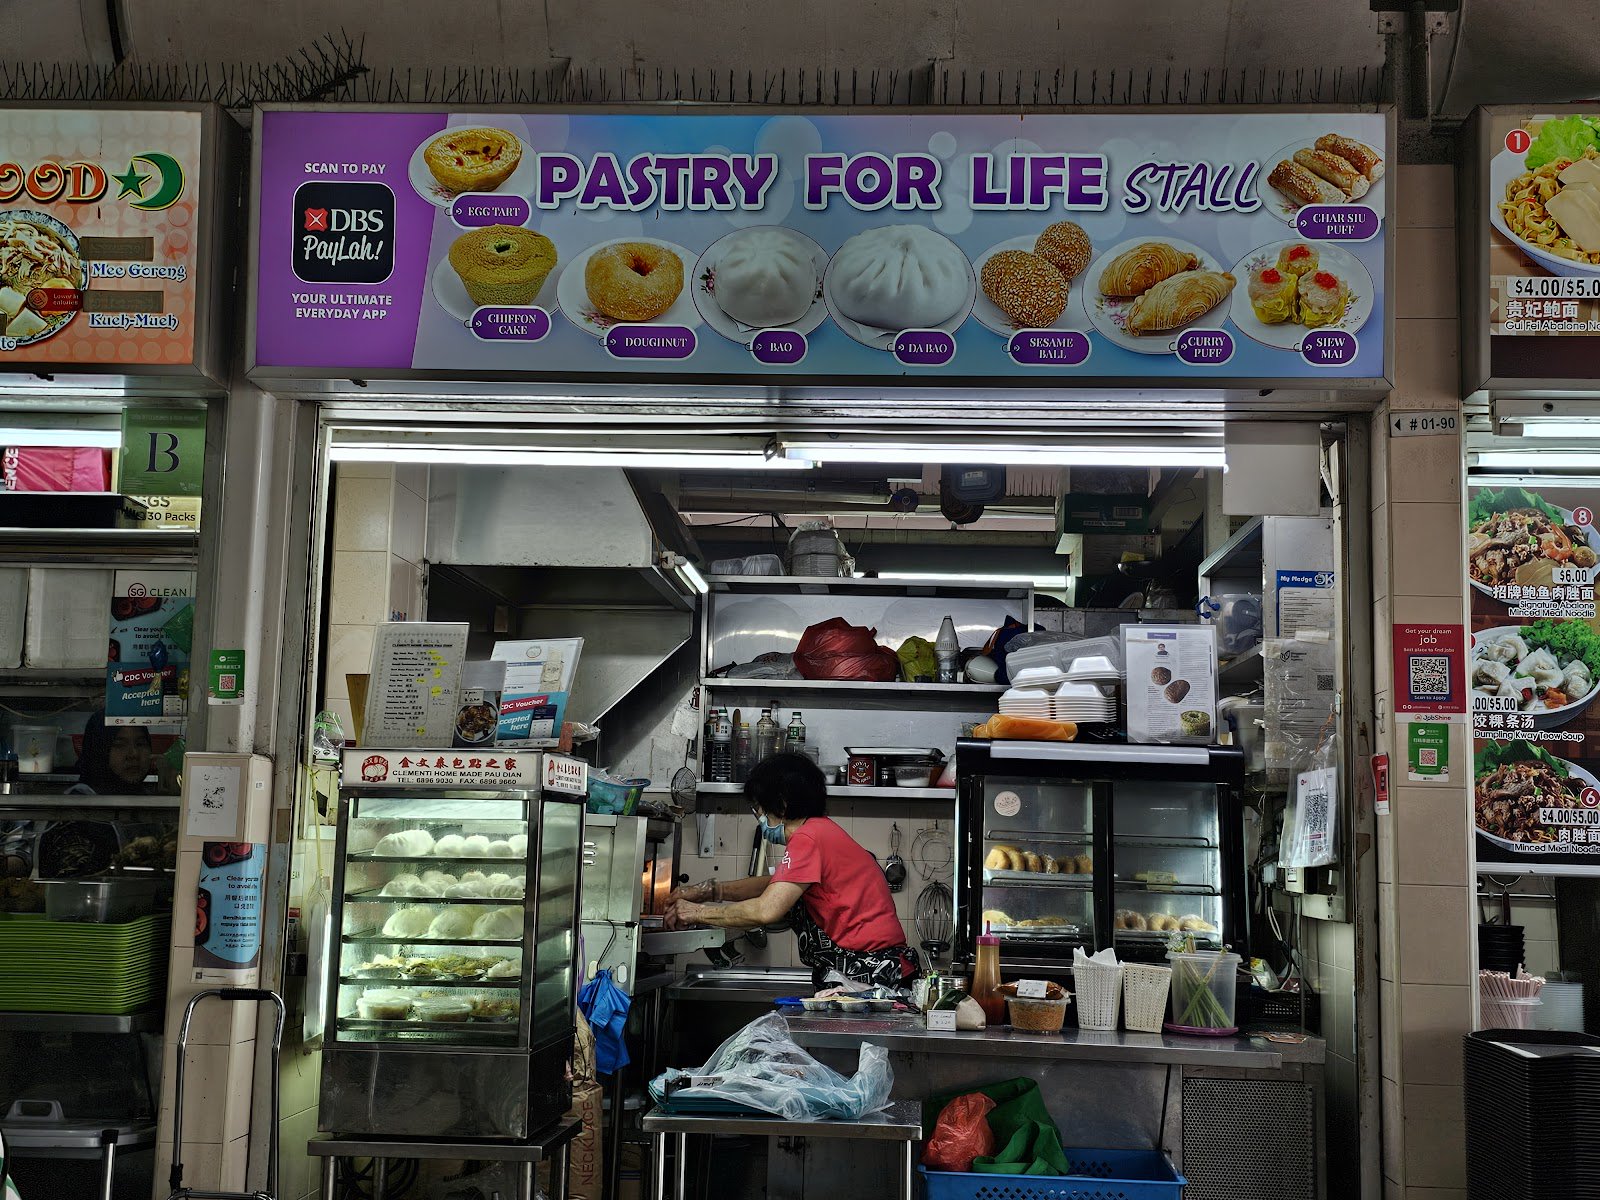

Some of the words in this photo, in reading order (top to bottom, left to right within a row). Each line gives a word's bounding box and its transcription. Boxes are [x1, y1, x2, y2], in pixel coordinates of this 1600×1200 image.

[1512, 132, 1523, 150] 1
[305, 162, 338, 174] SCAN
[342, 162, 358, 174] TO
[361, 162, 386, 174] PAY
[538, 155, 777, 209] PASTRY
[805, 155, 940, 209] FOR
[971, 155, 1105, 209] LIFE
[1125, 160, 1261, 212] STALL
[468, 206, 491, 217] EGG
[493, 206, 520, 218] TART
[330, 208, 384, 232] DBS
[1313, 213, 1345, 223] CHAR
[1347, 213, 1366, 223] SIU
[1326, 225, 1355, 235] PUFF
[303, 234, 384, 266] PayLah!
[91, 263, 124, 277] Mee
[128, 263, 185, 281] Goreng
[1515, 279, 1600, 296] $4.00/$5.0
[292, 292, 327, 305] YOUR
[329, 293, 392, 305] ULTIMATE
[296, 307, 360, 320] EVERYDAY
[362, 308, 387, 320] APP
[1506, 300, 1579, 318] 贵妃鲍面
[487, 313, 536, 324] CHIFFON
[498, 324, 528, 335] CAKE
[1506, 321, 1524, 331] Gui
[1526, 321, 1540, 331] Fei
[1542, 321, 1586, 331] Abalone
[624, 337, 687, 348] DOUGHNUT
[770, 341, 793, 352] BAO
[1029, 338, 1073, 348] SESAME
[1187, 337, 1226, 347] CURRY
[1316, 337, 1345, 347] SIEW
[908, 343, 924, 353] DA
[925, 343, 948, 353] BAO
[1194, 348, 1223, 359] PUFF
[1321, 348, 1343, 359] MAI
[1038, 349, 1067, 359] BALL
[1409, 418, 1418, 430] #
[1421, 417, 1455, 430] 01-90
[145, 432, 180, 473] B
[165, 512, 196, 521] Packs
[1578, 508, 1588, 523] 8
[1280, 575, 1290, 583] My
[1560, 569, 1587, 582] $6.00
[130, 589, 145, 597] SG
[150, 588, 187, 597] CLEAN
[1520, 601, 1557, 610] Signature
[1560, 601, 1595, 610] Abalone
[1509, 609, 1541, 617] Minced
[1543, 609, 1562, 617] Meat
[1565, 609, 1595, 617] Noodle
[1419, 634, 1437, 645] job
[124, 674, 141, 682] CDC
[515, 699, 544, 708] Voucher
[499, 714, 531, 724] ccepted
[1474, 731, 1513, 740] Dumpling
[1515, 731, 1538, 741] Kway
[1539, 732, 1560, 740] Teow
[1563, 732, 1585, 741] Soup
[1585, 791, 1596, 804] 6
[1542, 810, 1599, 824] $4.00/$5.00
[1514, 844, 1546, 852] Minced
[1547, 844, 1569, 852] Meat
[1571, 845, 1600, 853] Noodle
